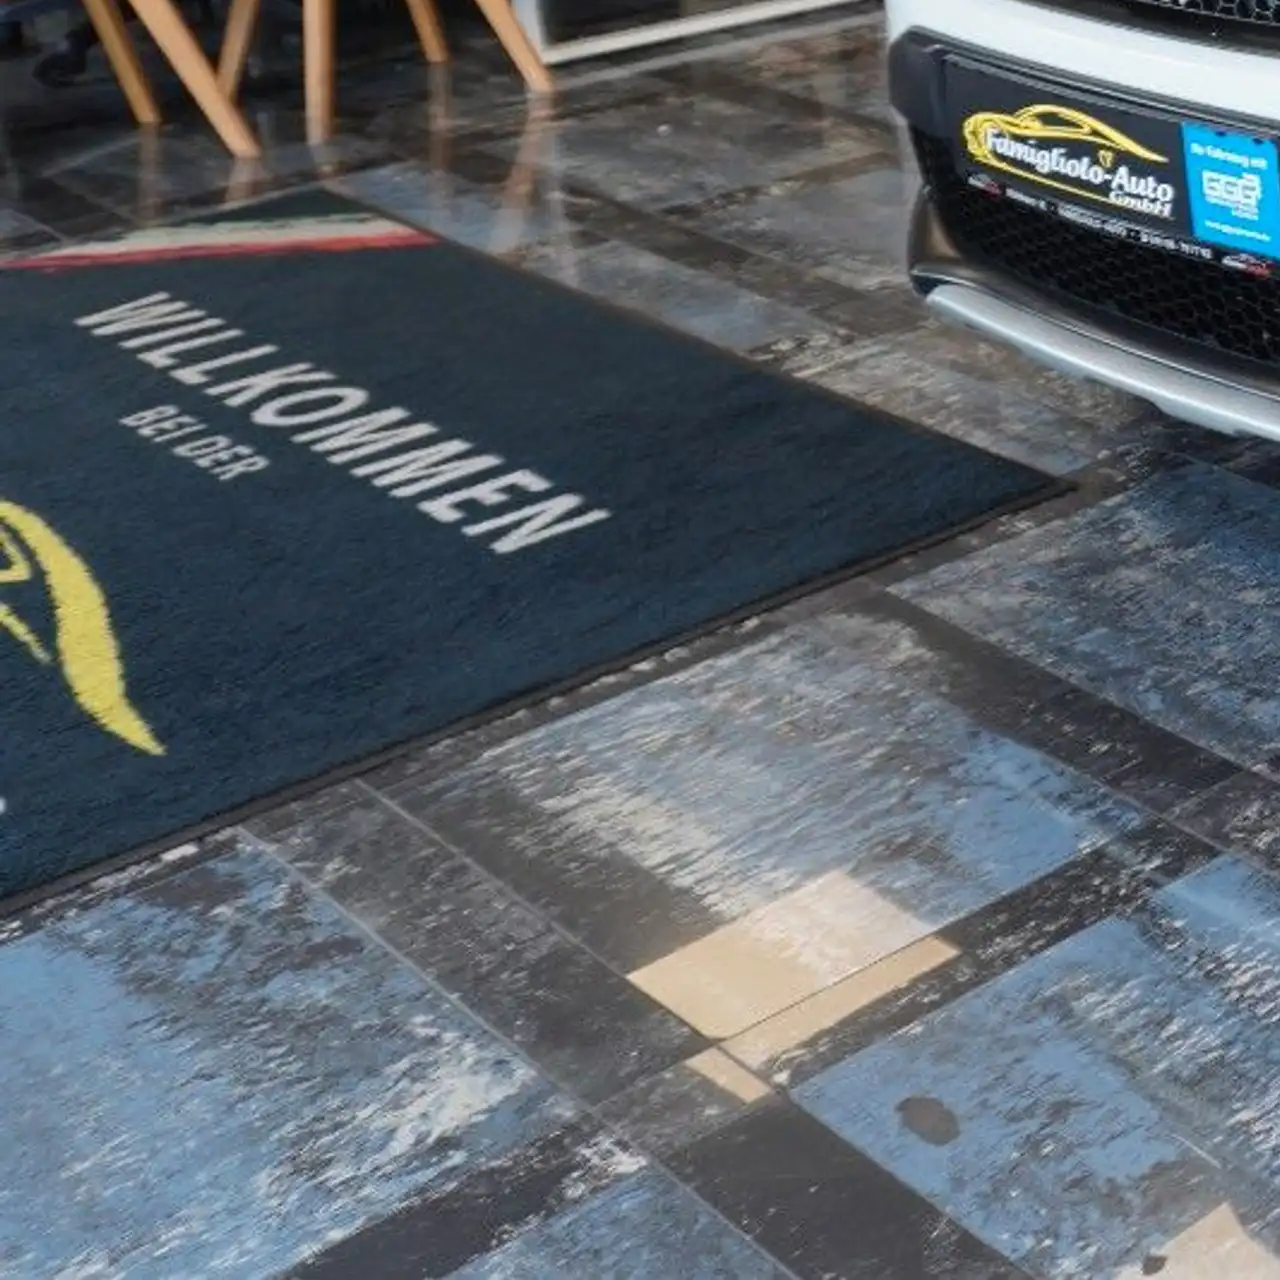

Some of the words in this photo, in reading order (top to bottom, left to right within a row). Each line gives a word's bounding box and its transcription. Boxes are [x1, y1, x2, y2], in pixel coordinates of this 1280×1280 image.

[983, 128, 1175, 202] Famigliolo-Auto
[1108, 189, 1173, 218] GmbH
[73, 290, 611, 555] WILLKOMMEN
[118, 404, 210, 456] BEI
[174, 432, 272, 482] DER
